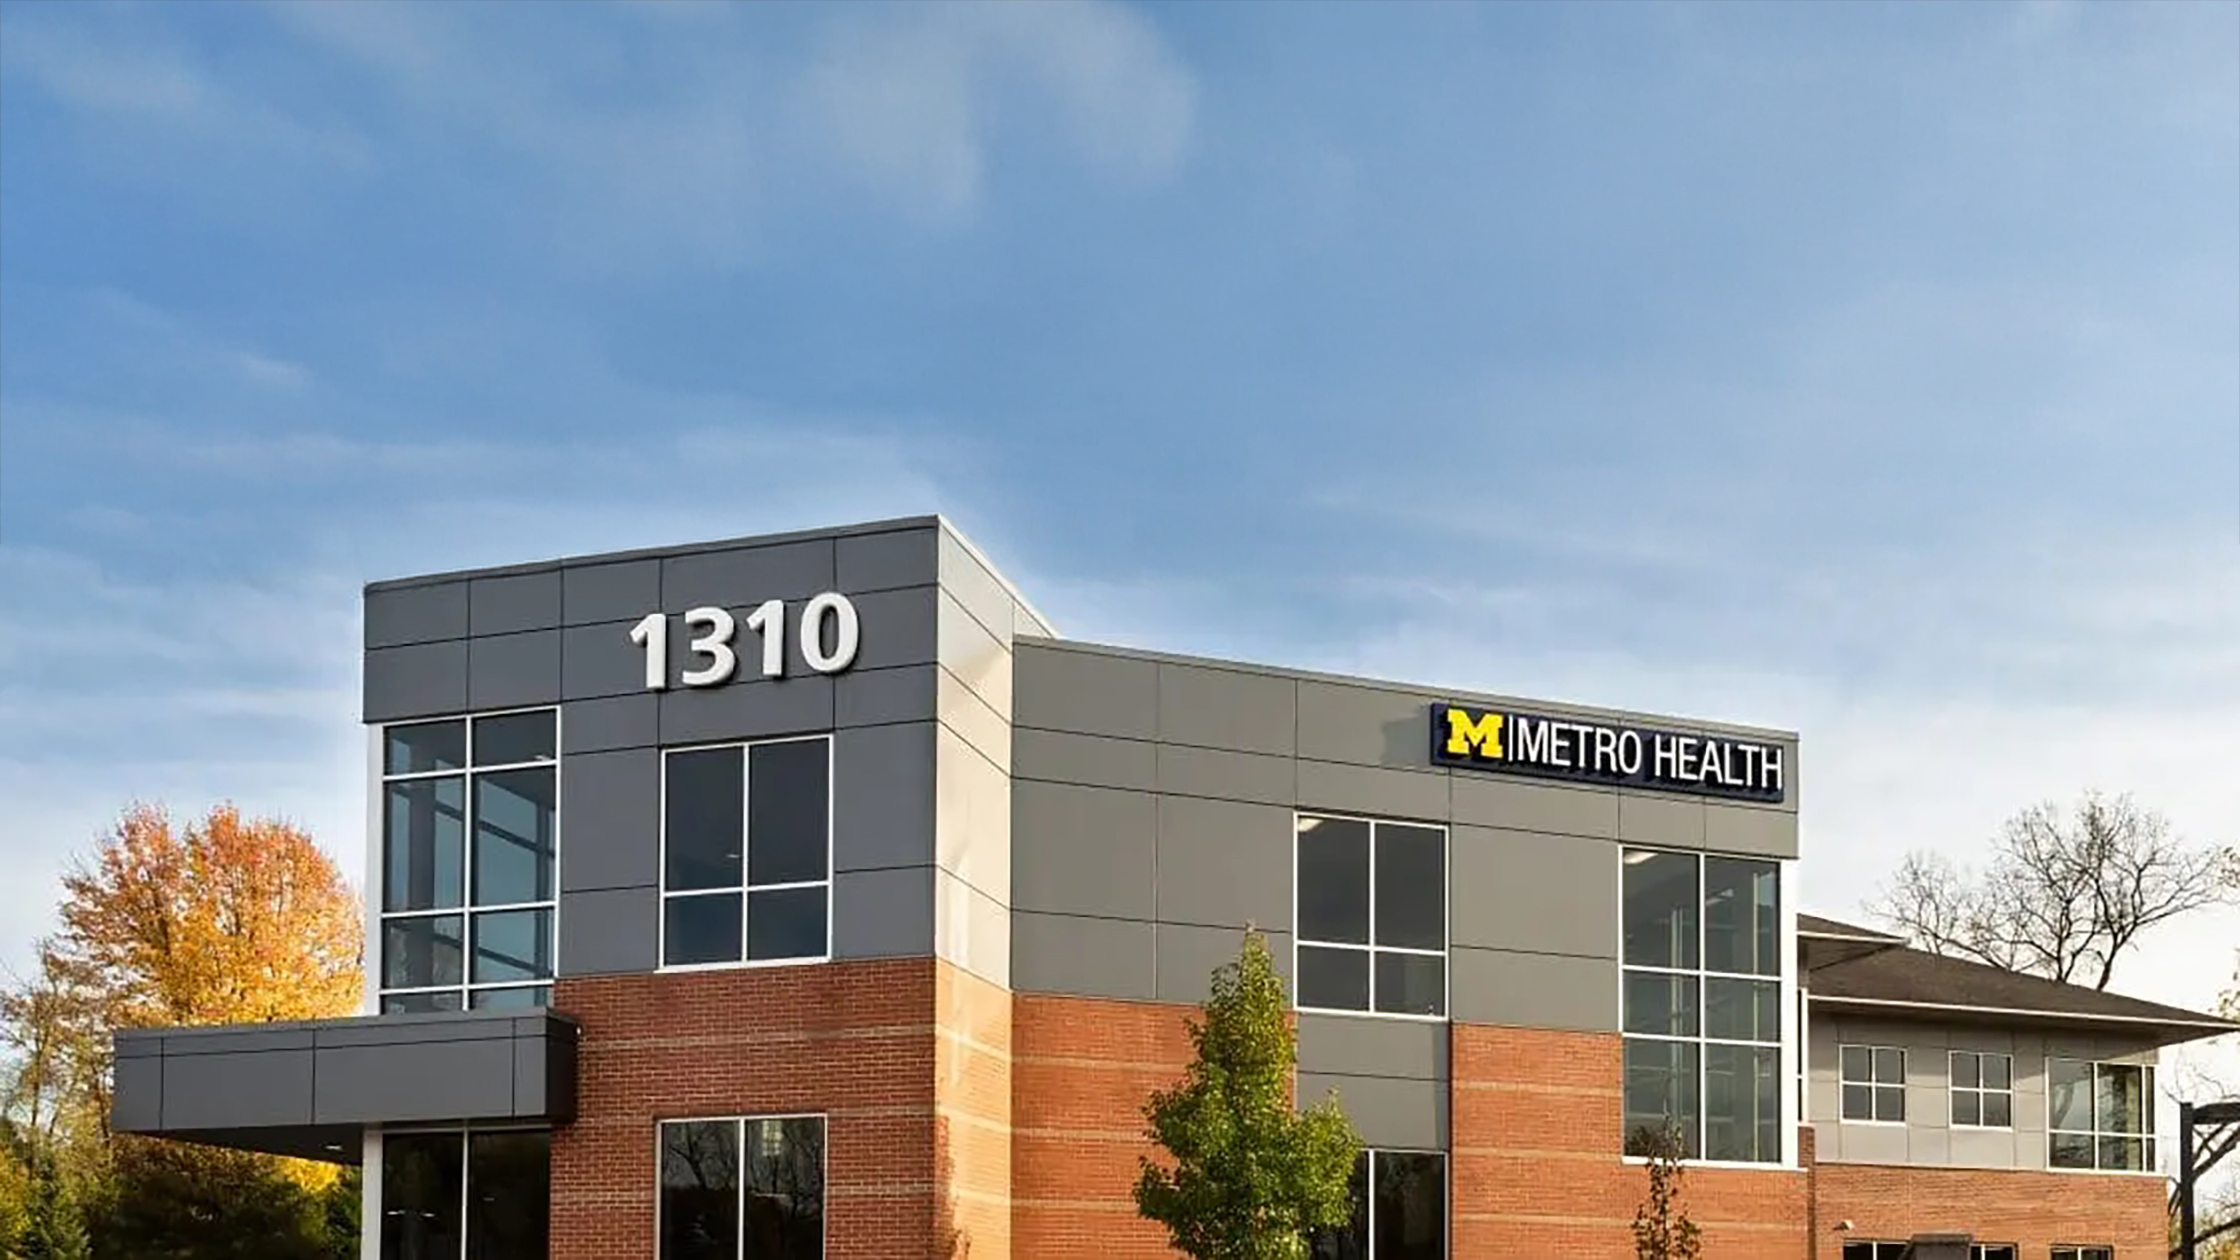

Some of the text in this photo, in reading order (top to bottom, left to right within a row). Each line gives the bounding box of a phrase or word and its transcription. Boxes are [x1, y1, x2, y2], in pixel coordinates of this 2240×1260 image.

[630, 592, 859, 689] 1310
[1446, 708, 1784, 790] M METRO HEALTH
